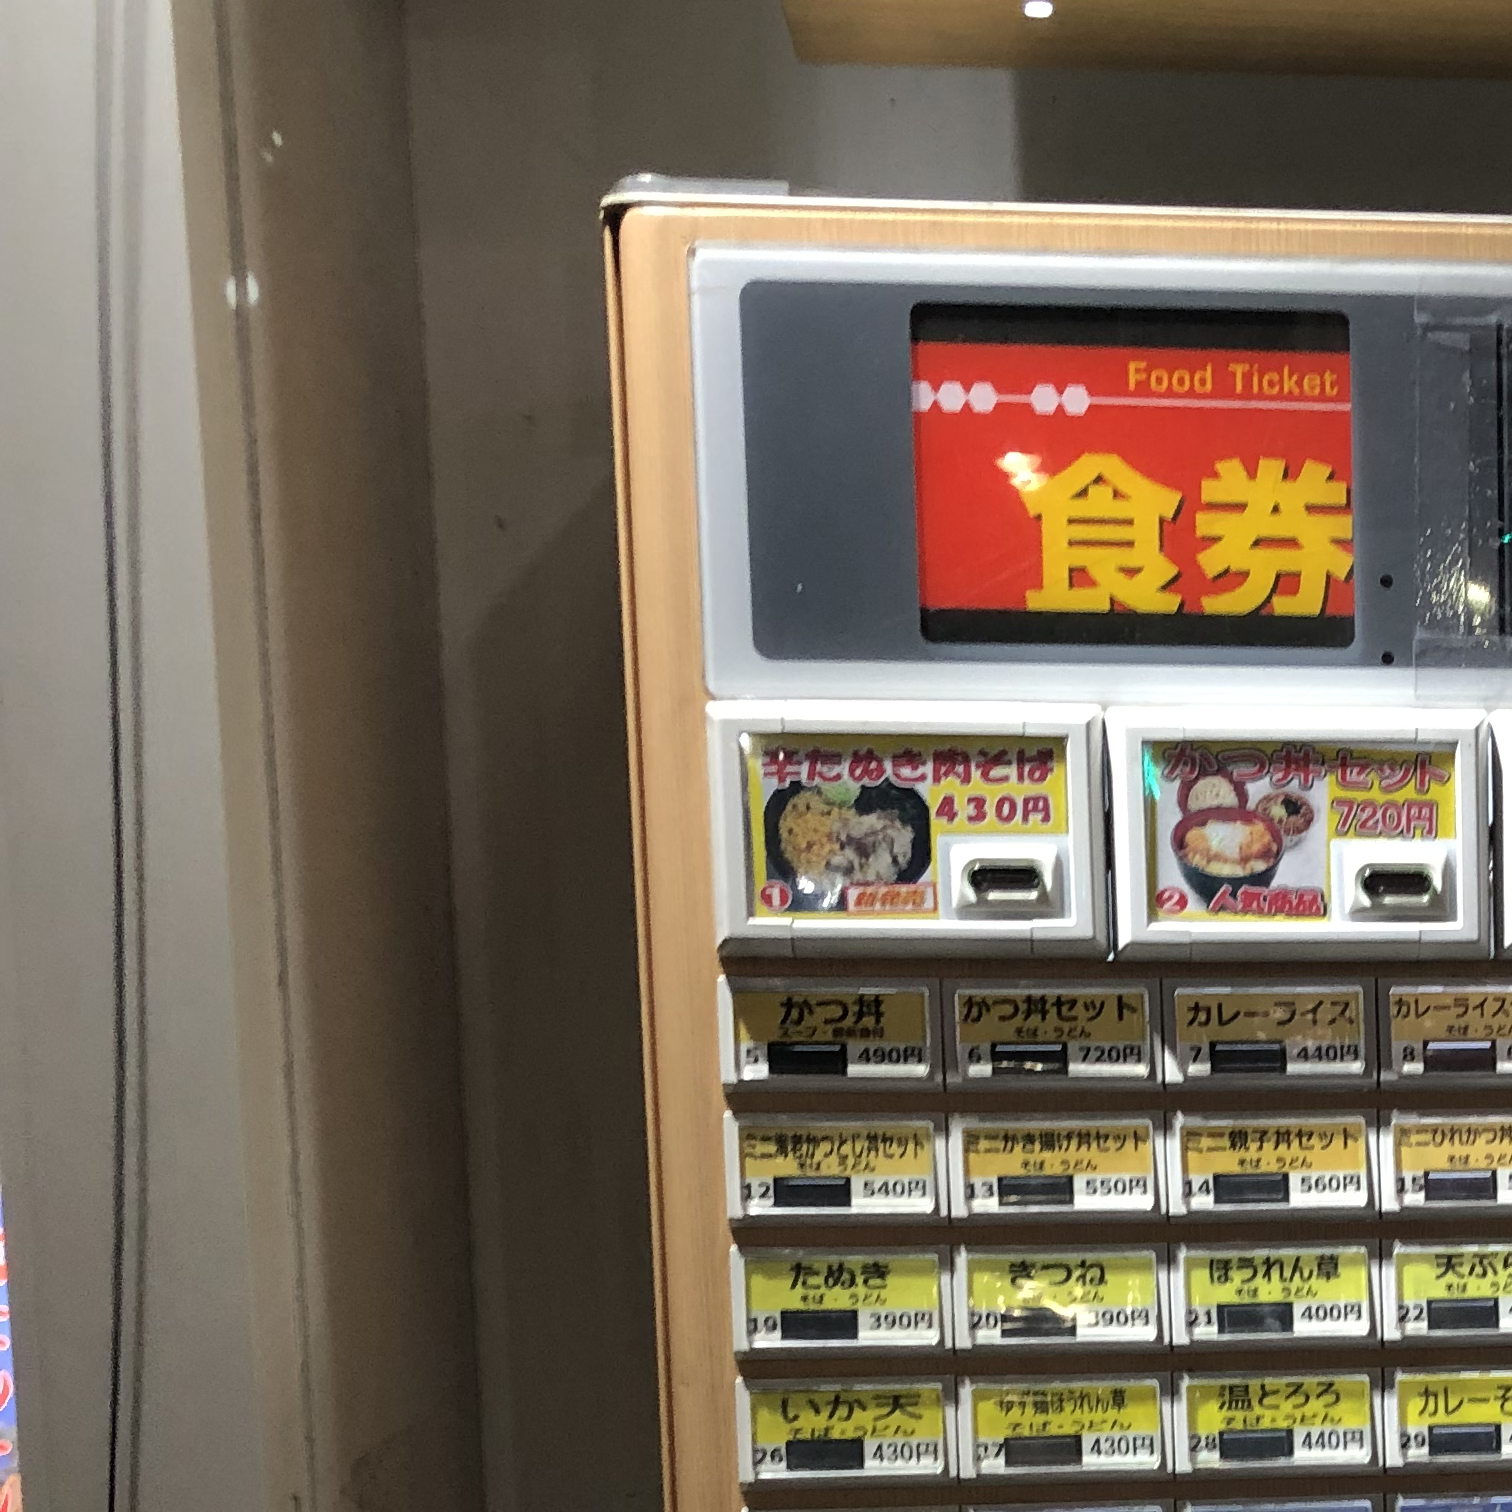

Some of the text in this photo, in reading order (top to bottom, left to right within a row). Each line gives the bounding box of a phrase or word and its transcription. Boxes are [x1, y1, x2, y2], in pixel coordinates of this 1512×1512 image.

[1128, 362, 1339, 397] Food Ticket
[1019, 453, 1354, 617] 食券
[1162, 742, 1450, 792] かつ丼セット
[936, 794, 1051, 824] 430円
[1332, 800, 1438, 837] 720円
[1208, 886, 1325, 917] 人気商品
[779, 995, 884, 1026] かつ丼
[962, 995, 1138, 1023] かつ丼セット
[1186, 1001, 1355, 1028] カレーライス
[857, 1045, 923, 1064] 490円
[968, 1045, 1141, 1064] 6 720円
[1189, 1045, 1360, 1062] 7 440円
[1402, 1046, 1415, 1061] 8
[1186, 1128, 1359, 1153] ミニ親子丼セット
[747, 1179, 926, 1199] 12 540円
[1086, 1177, 1148, 1197] 550円
[1185, 1174, 1360, 1197] 14 560円
[789, 1262, 890, 1290] たぬき
[1009, 1260, 1108, 1287] きつね
[1210, 1255, 1340, 1284] ほうれん草
[870, 1313, 932, 1330] 390円
[1301, 1304, 1361, 1321] 400円
[781, 1392, 922, 1423] いか天
[1217, 1383, 1340, 1412] 温とろろ
[873, 1442, 939, 1462] 430円
[1090, 1436, 1154, 1457] 430円
[1301, 1430, 1364, 1451] 440円
